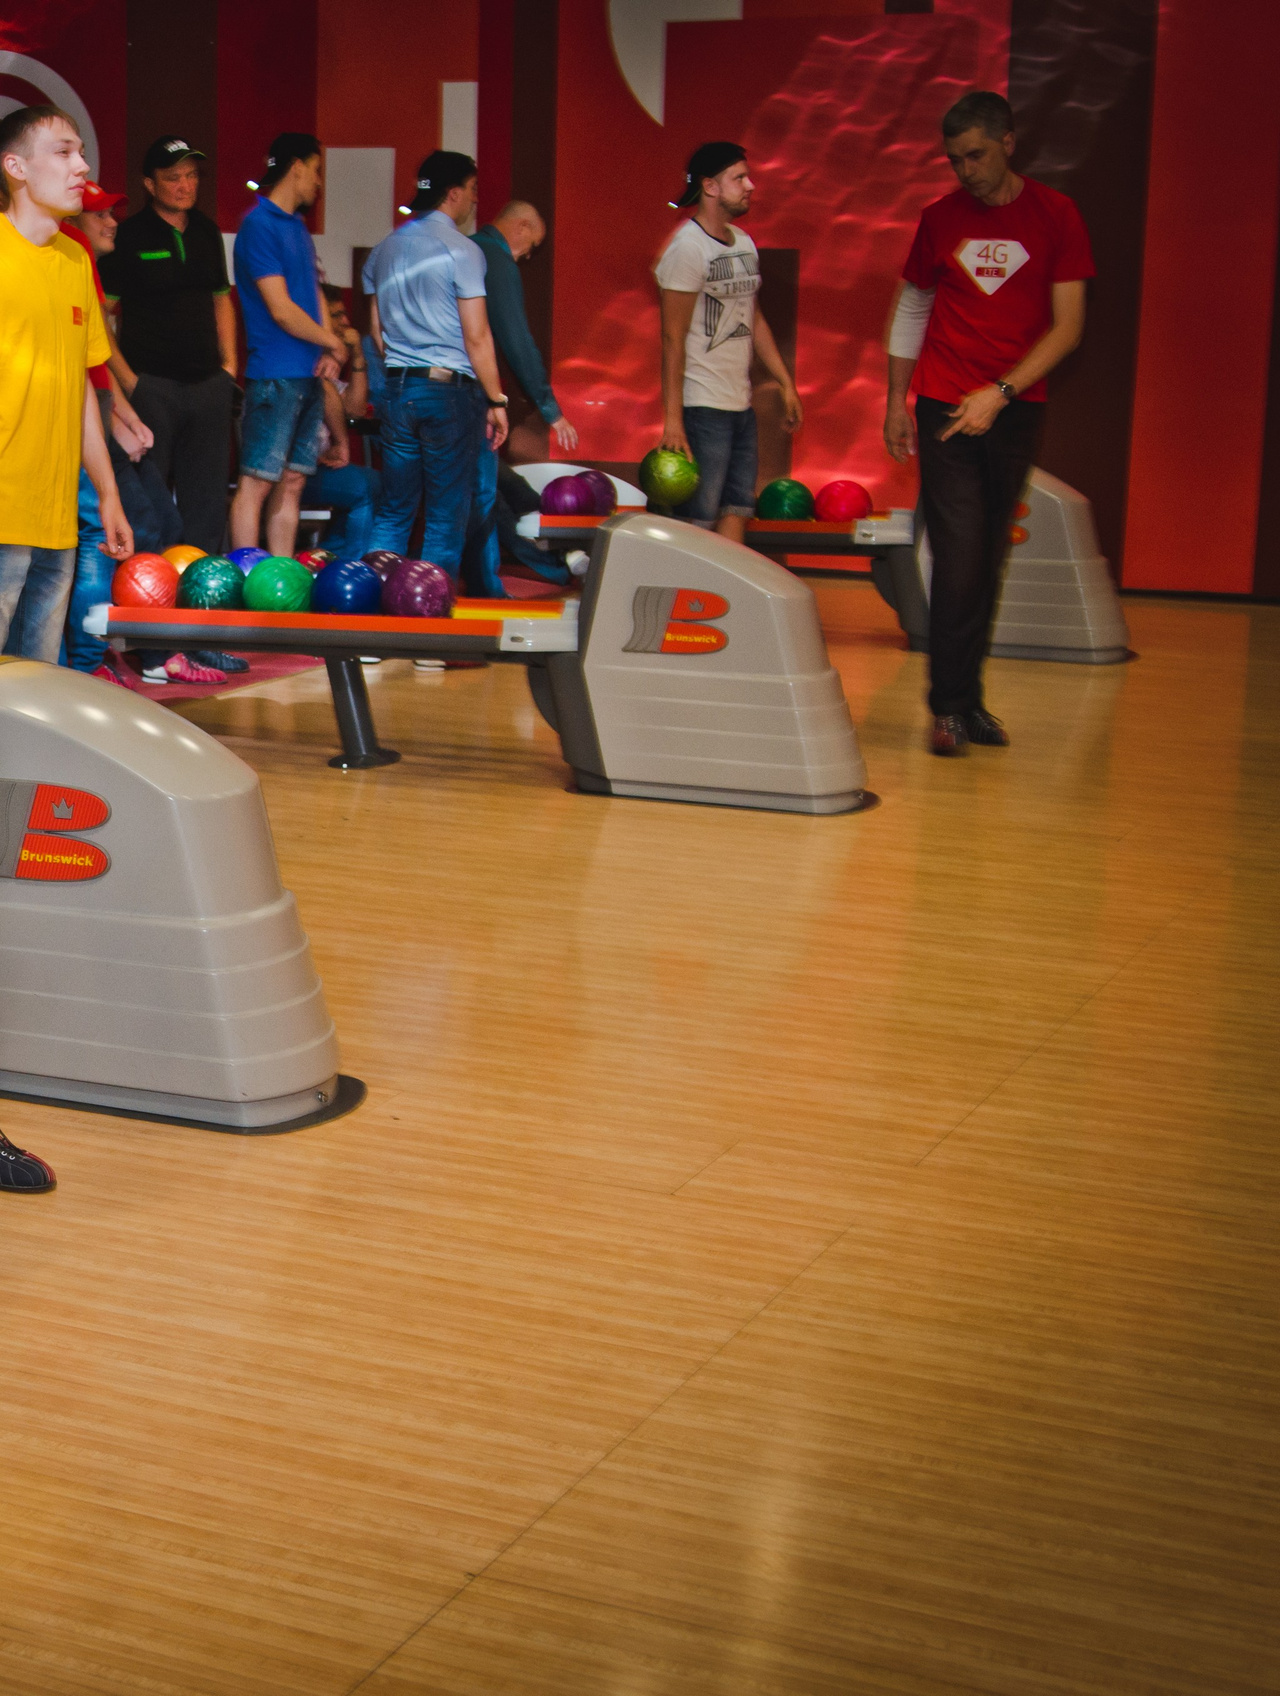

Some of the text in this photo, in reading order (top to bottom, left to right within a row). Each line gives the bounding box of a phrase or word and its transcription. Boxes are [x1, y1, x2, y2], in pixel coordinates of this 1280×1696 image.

[977, 243, 1009, 265] 4G
[983, 268, 999, 277] LTE
[665, 632, 717, 644] Brunswick
[20, 849, 94, 867] Brunswick
